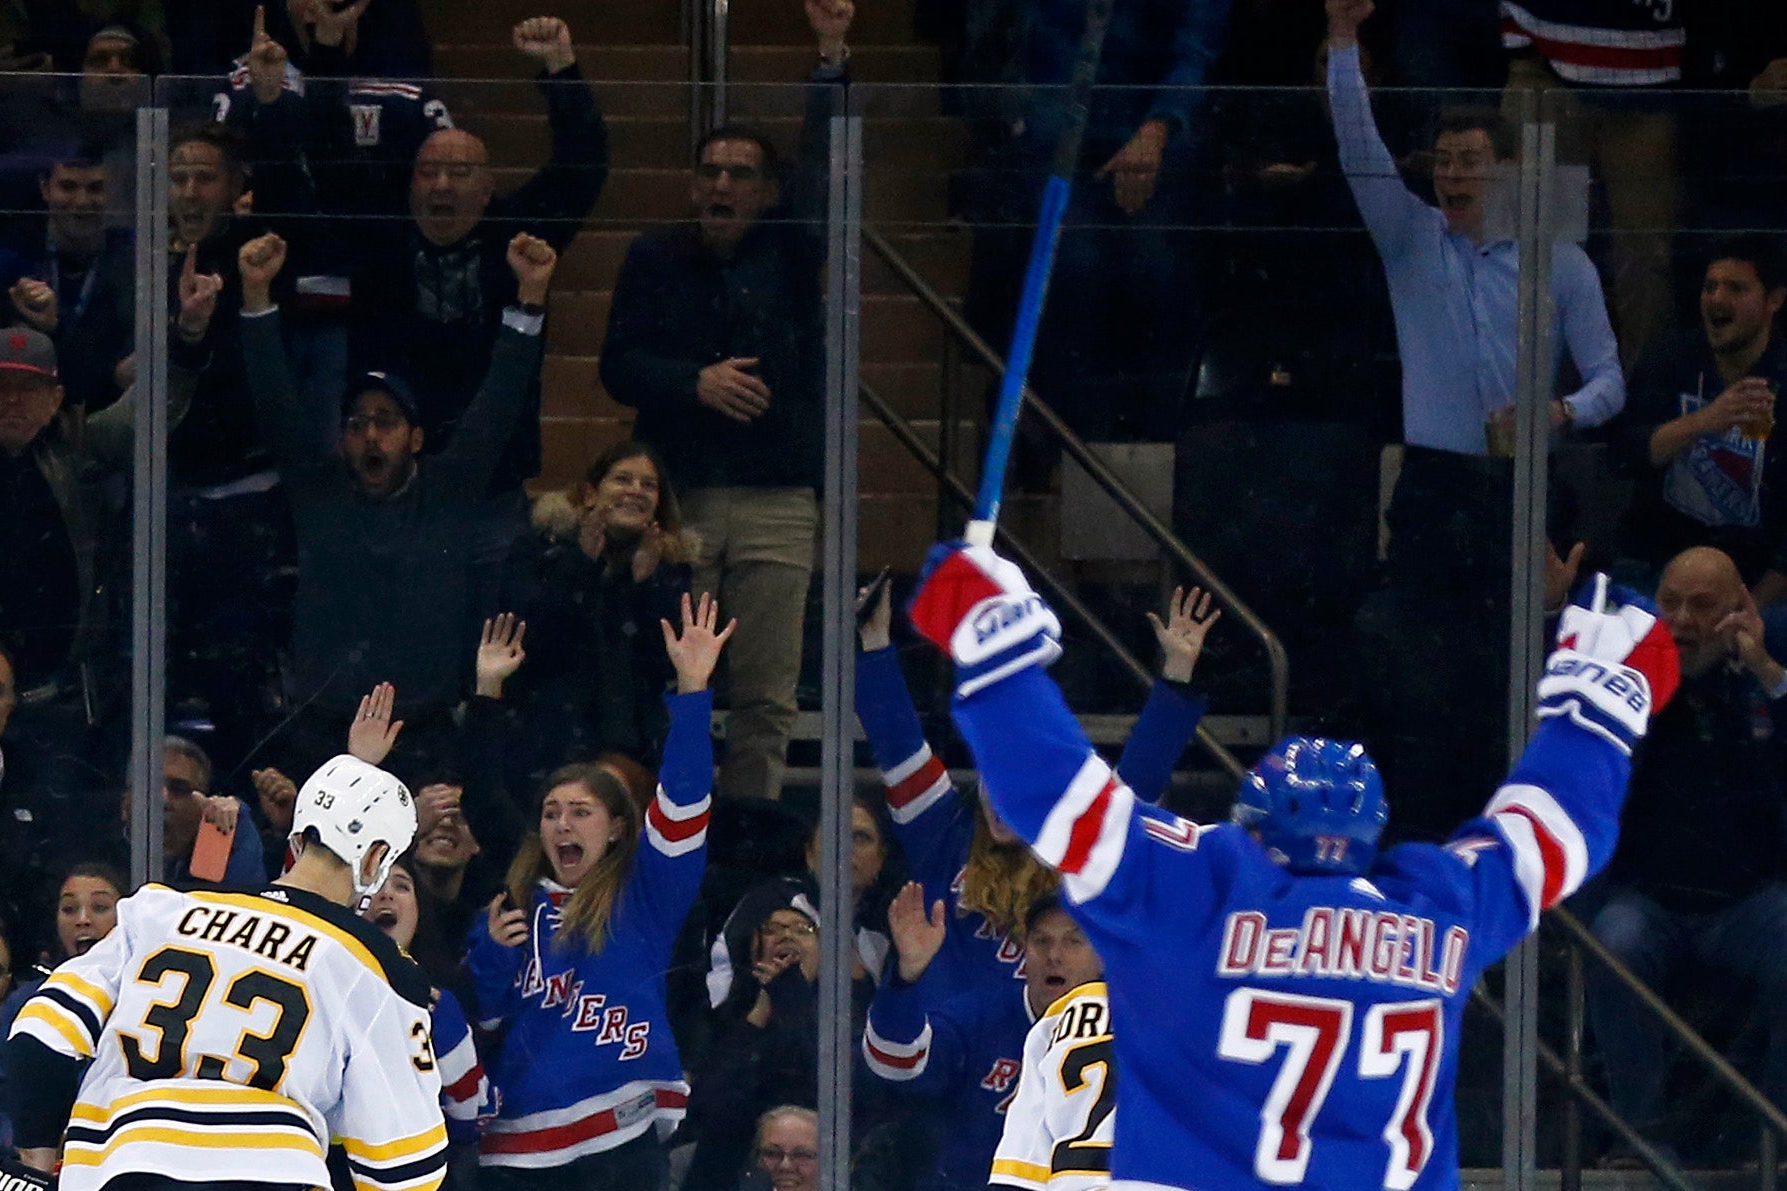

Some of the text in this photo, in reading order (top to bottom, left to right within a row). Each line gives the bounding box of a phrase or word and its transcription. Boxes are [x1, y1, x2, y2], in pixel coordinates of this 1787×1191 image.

[314, 790, 335, 810] 33
[1315, 836, 1350, 863] 77
[177, 906, 319, 973] CHARA
[115, 943, 313, 1092] 33
[514, 959, 650, 1062] ANERS
